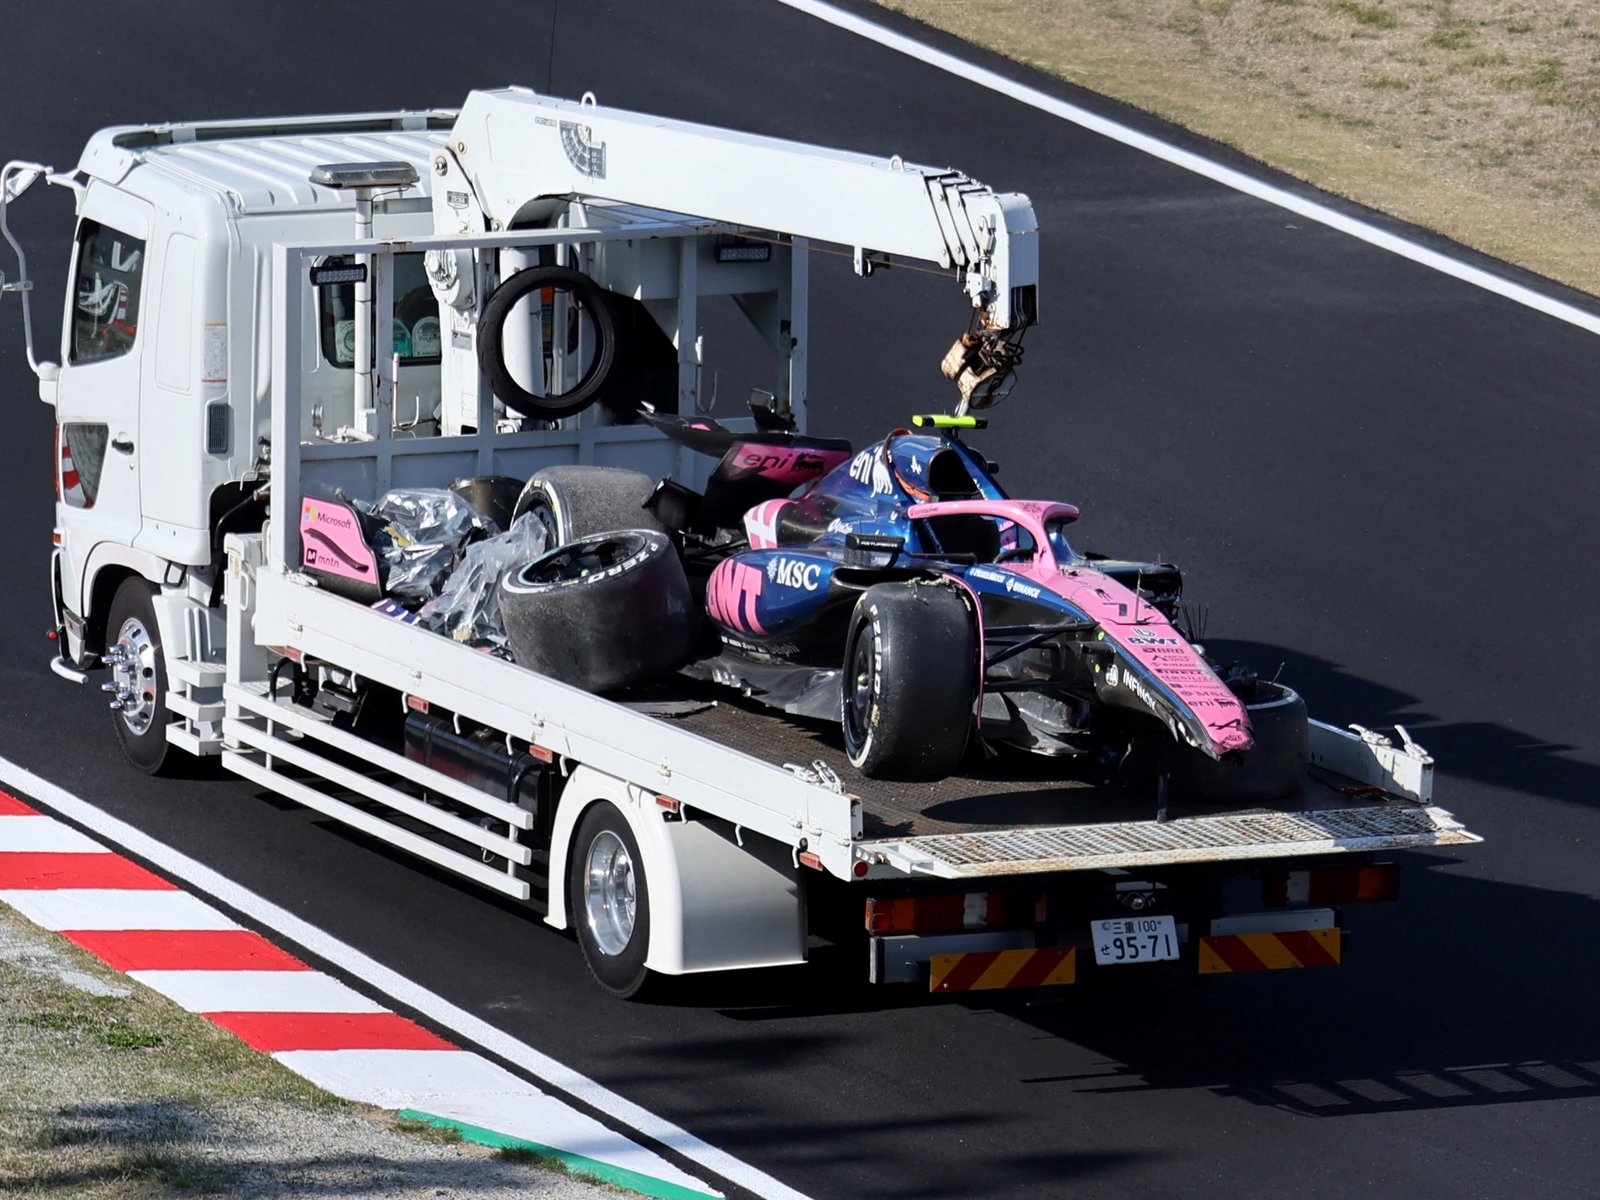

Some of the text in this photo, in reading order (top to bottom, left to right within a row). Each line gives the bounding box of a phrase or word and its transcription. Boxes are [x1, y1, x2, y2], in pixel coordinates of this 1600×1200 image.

[743, 453, 793, 470] eni
[849, 450, 874, 485] eni
[317, 512, 352, 530] Microsoft
[317, 556, 340, 568] mntn
[776, 557, 822, 592] MSC
[1012, 581, 1041, 599] BINANCE
[1126, 637, 1179, 645] BWT
[1138, 920, 1157, 932] 100
[1100, 934, 1172, 960] せ 95-71
